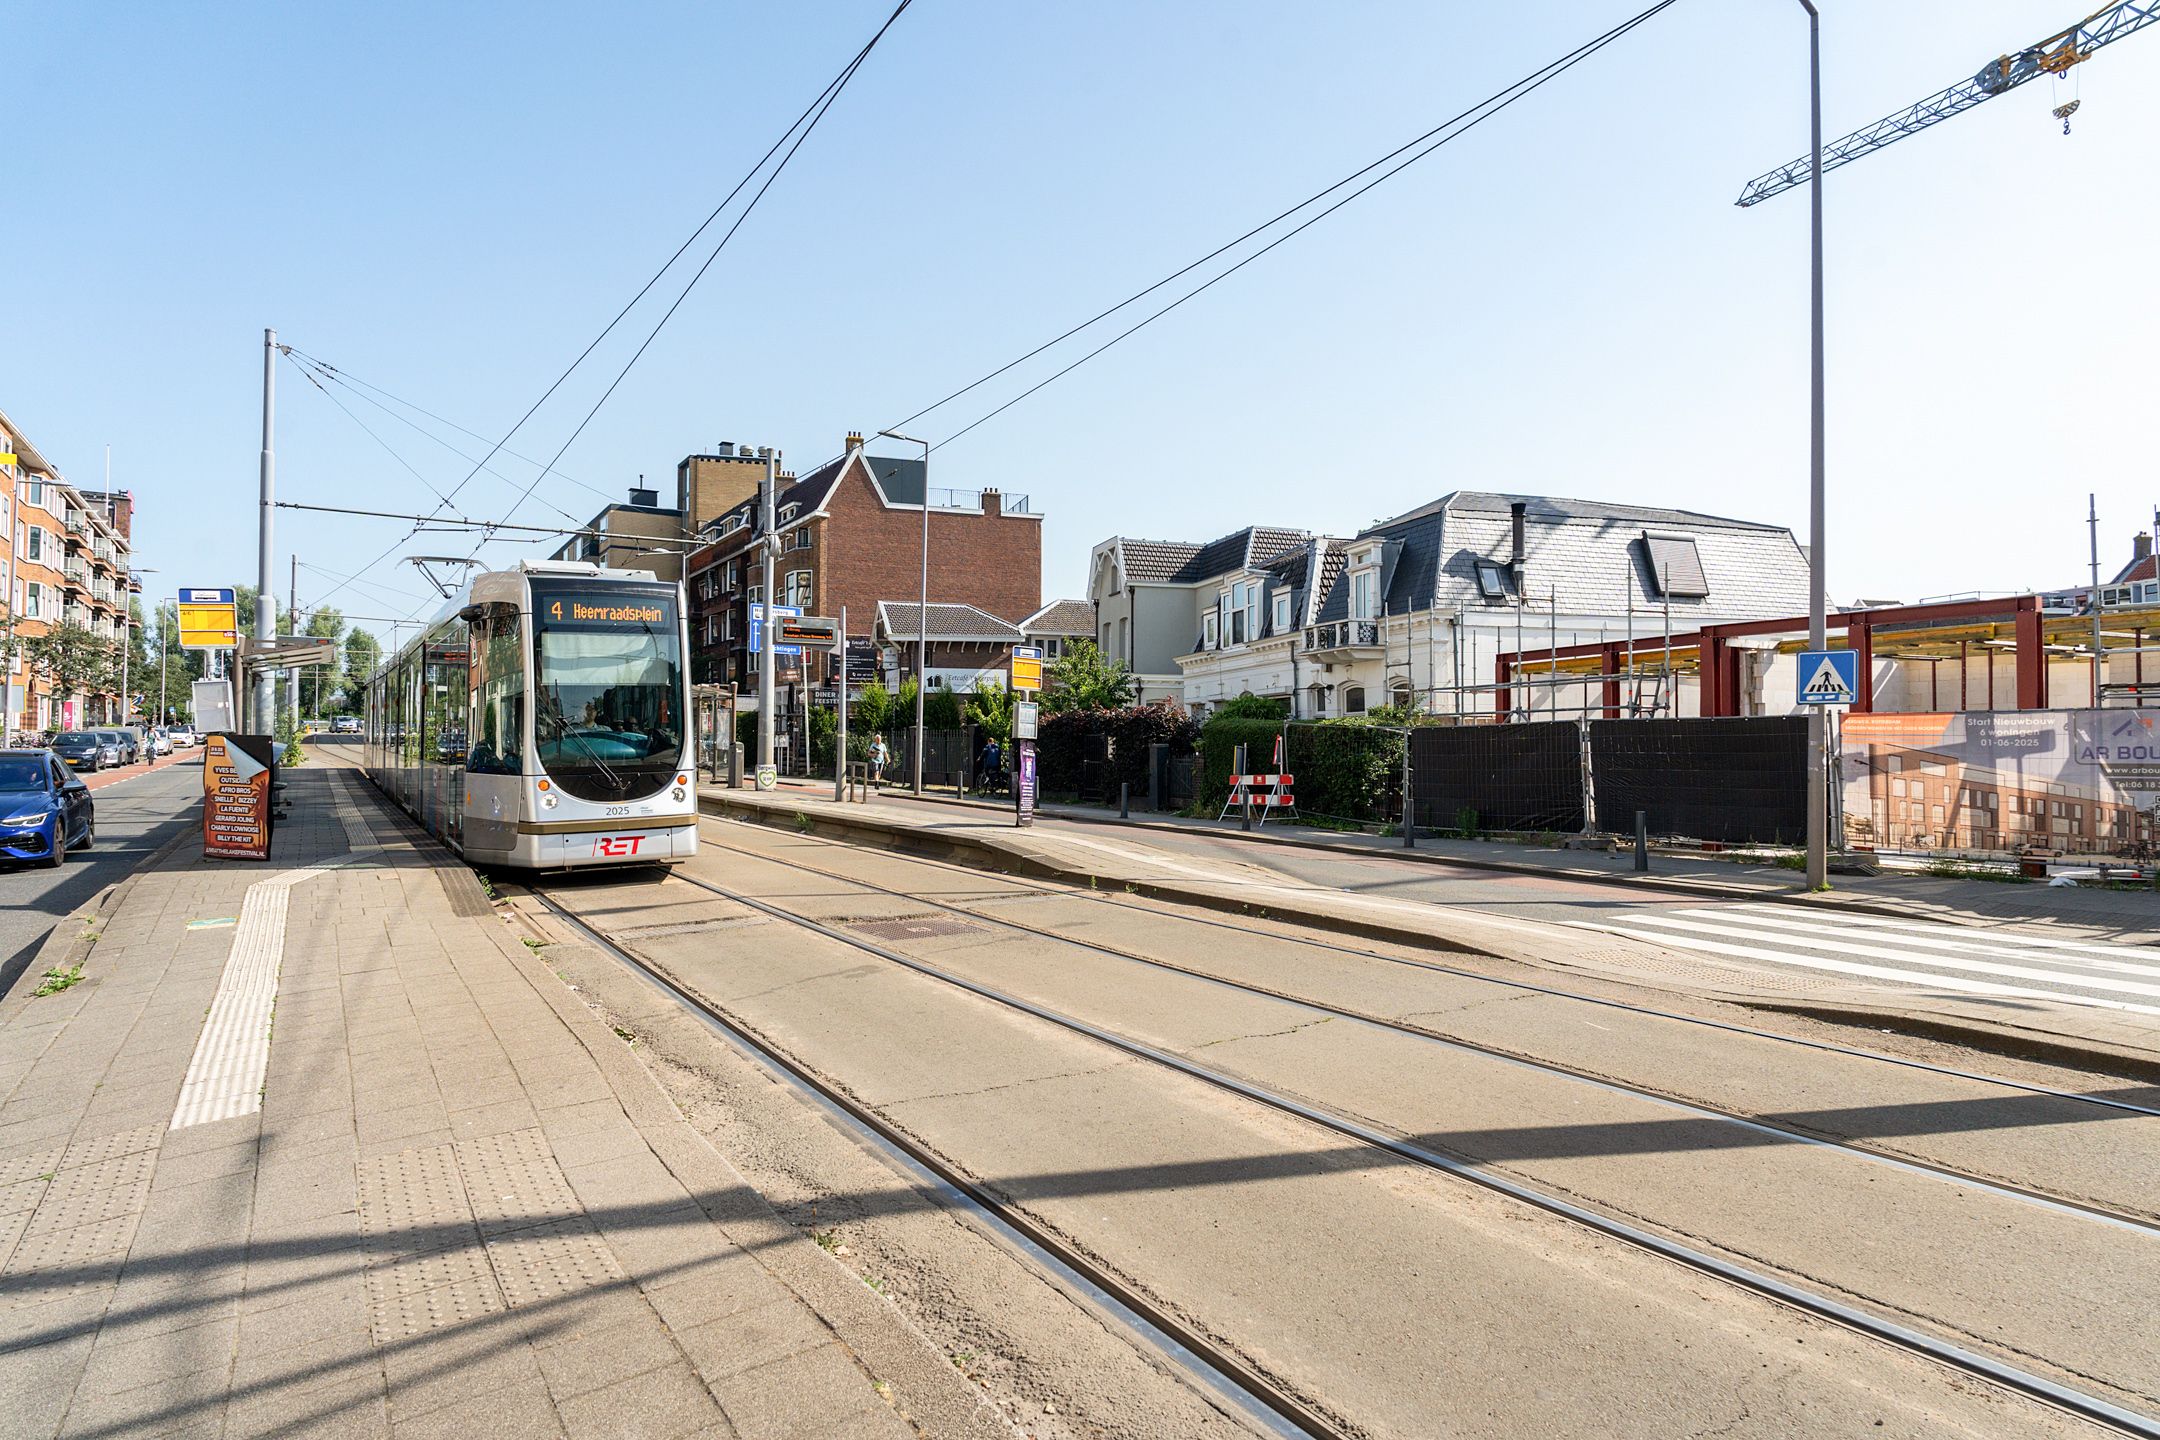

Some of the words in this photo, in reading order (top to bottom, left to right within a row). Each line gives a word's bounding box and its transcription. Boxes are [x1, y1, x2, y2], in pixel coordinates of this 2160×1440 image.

[551, 601, 563, 621] 4
[573, 602, 662, 622] Heemraadsplein
[1967, 718, 1991, 726] Start
[1993, 717, 2056, 726] Nieuwbouw
[1980, 728, 1986, 736] 6
[1988, 727, 2040, 738] woningen
[1981, 738, 2040, 747] 01-06-2025
[2081, 746, 2110, 759] AR
[2115, 781, 2143, 789] Tel:06
[2145, 781, 2156, 789] 18
[229, 806, 249, 814] FUENTE
[605, 806, 630, 816] 2025
[599, 835, 646, 857] RET
